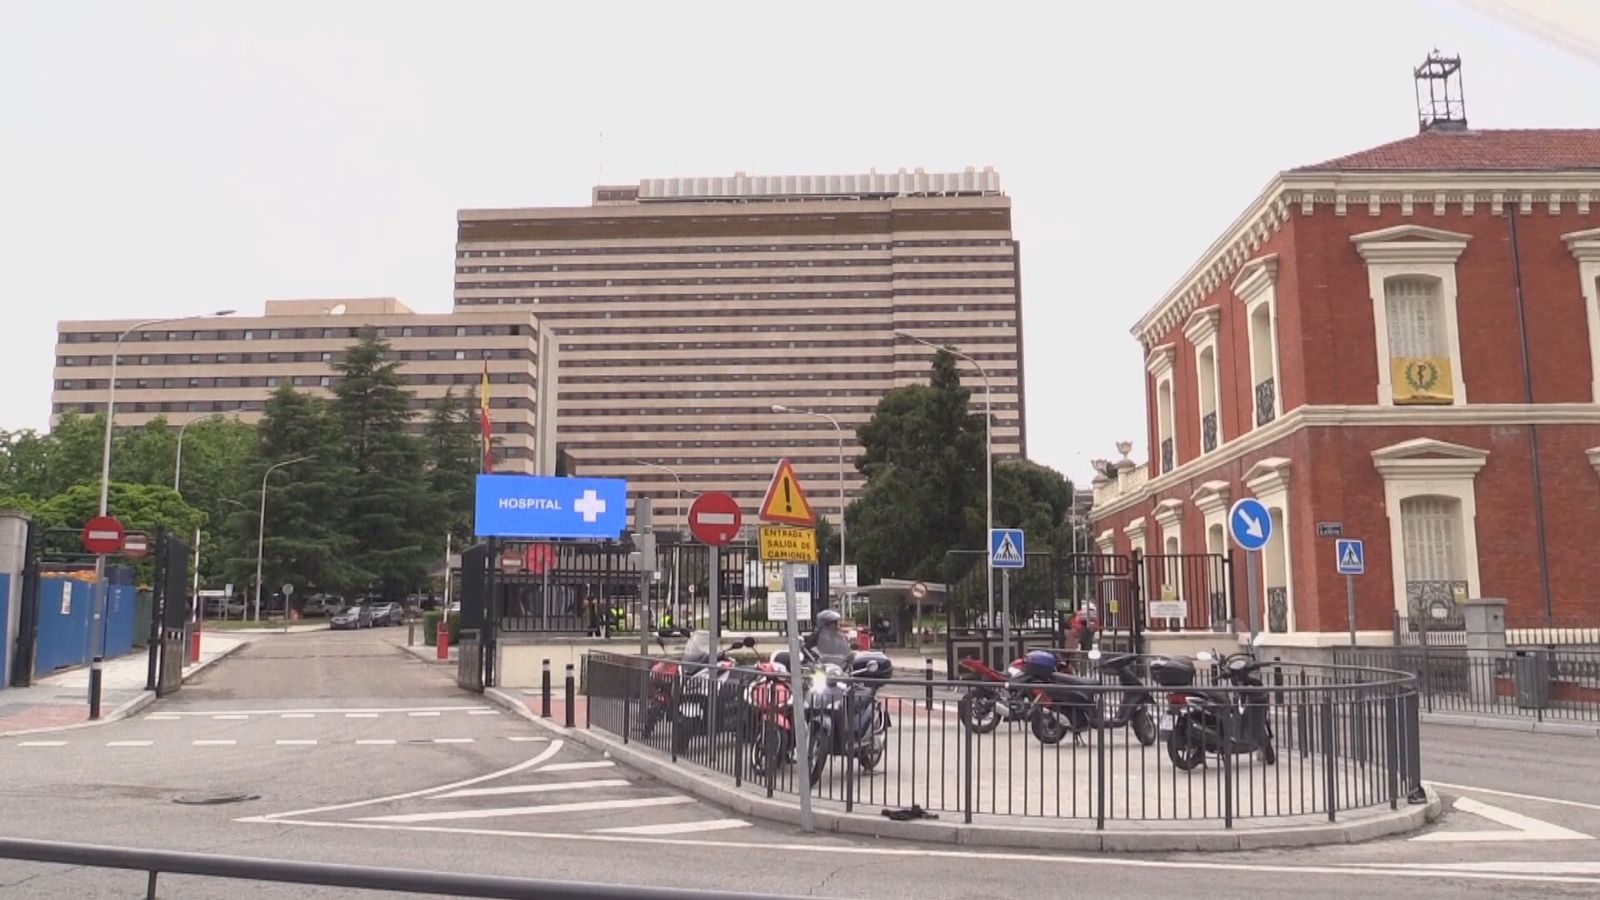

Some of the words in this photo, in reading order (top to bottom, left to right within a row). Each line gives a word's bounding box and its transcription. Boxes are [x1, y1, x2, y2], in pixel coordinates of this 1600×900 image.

[499, 498, 562, 510] HOSPITAL
[764, 528, 803, 538] ENTRADA
[767, 540, 797, 548] SALIDA
[801, 542, 811, 550] DE
[767, 550, 811, 560] CAMIONES
